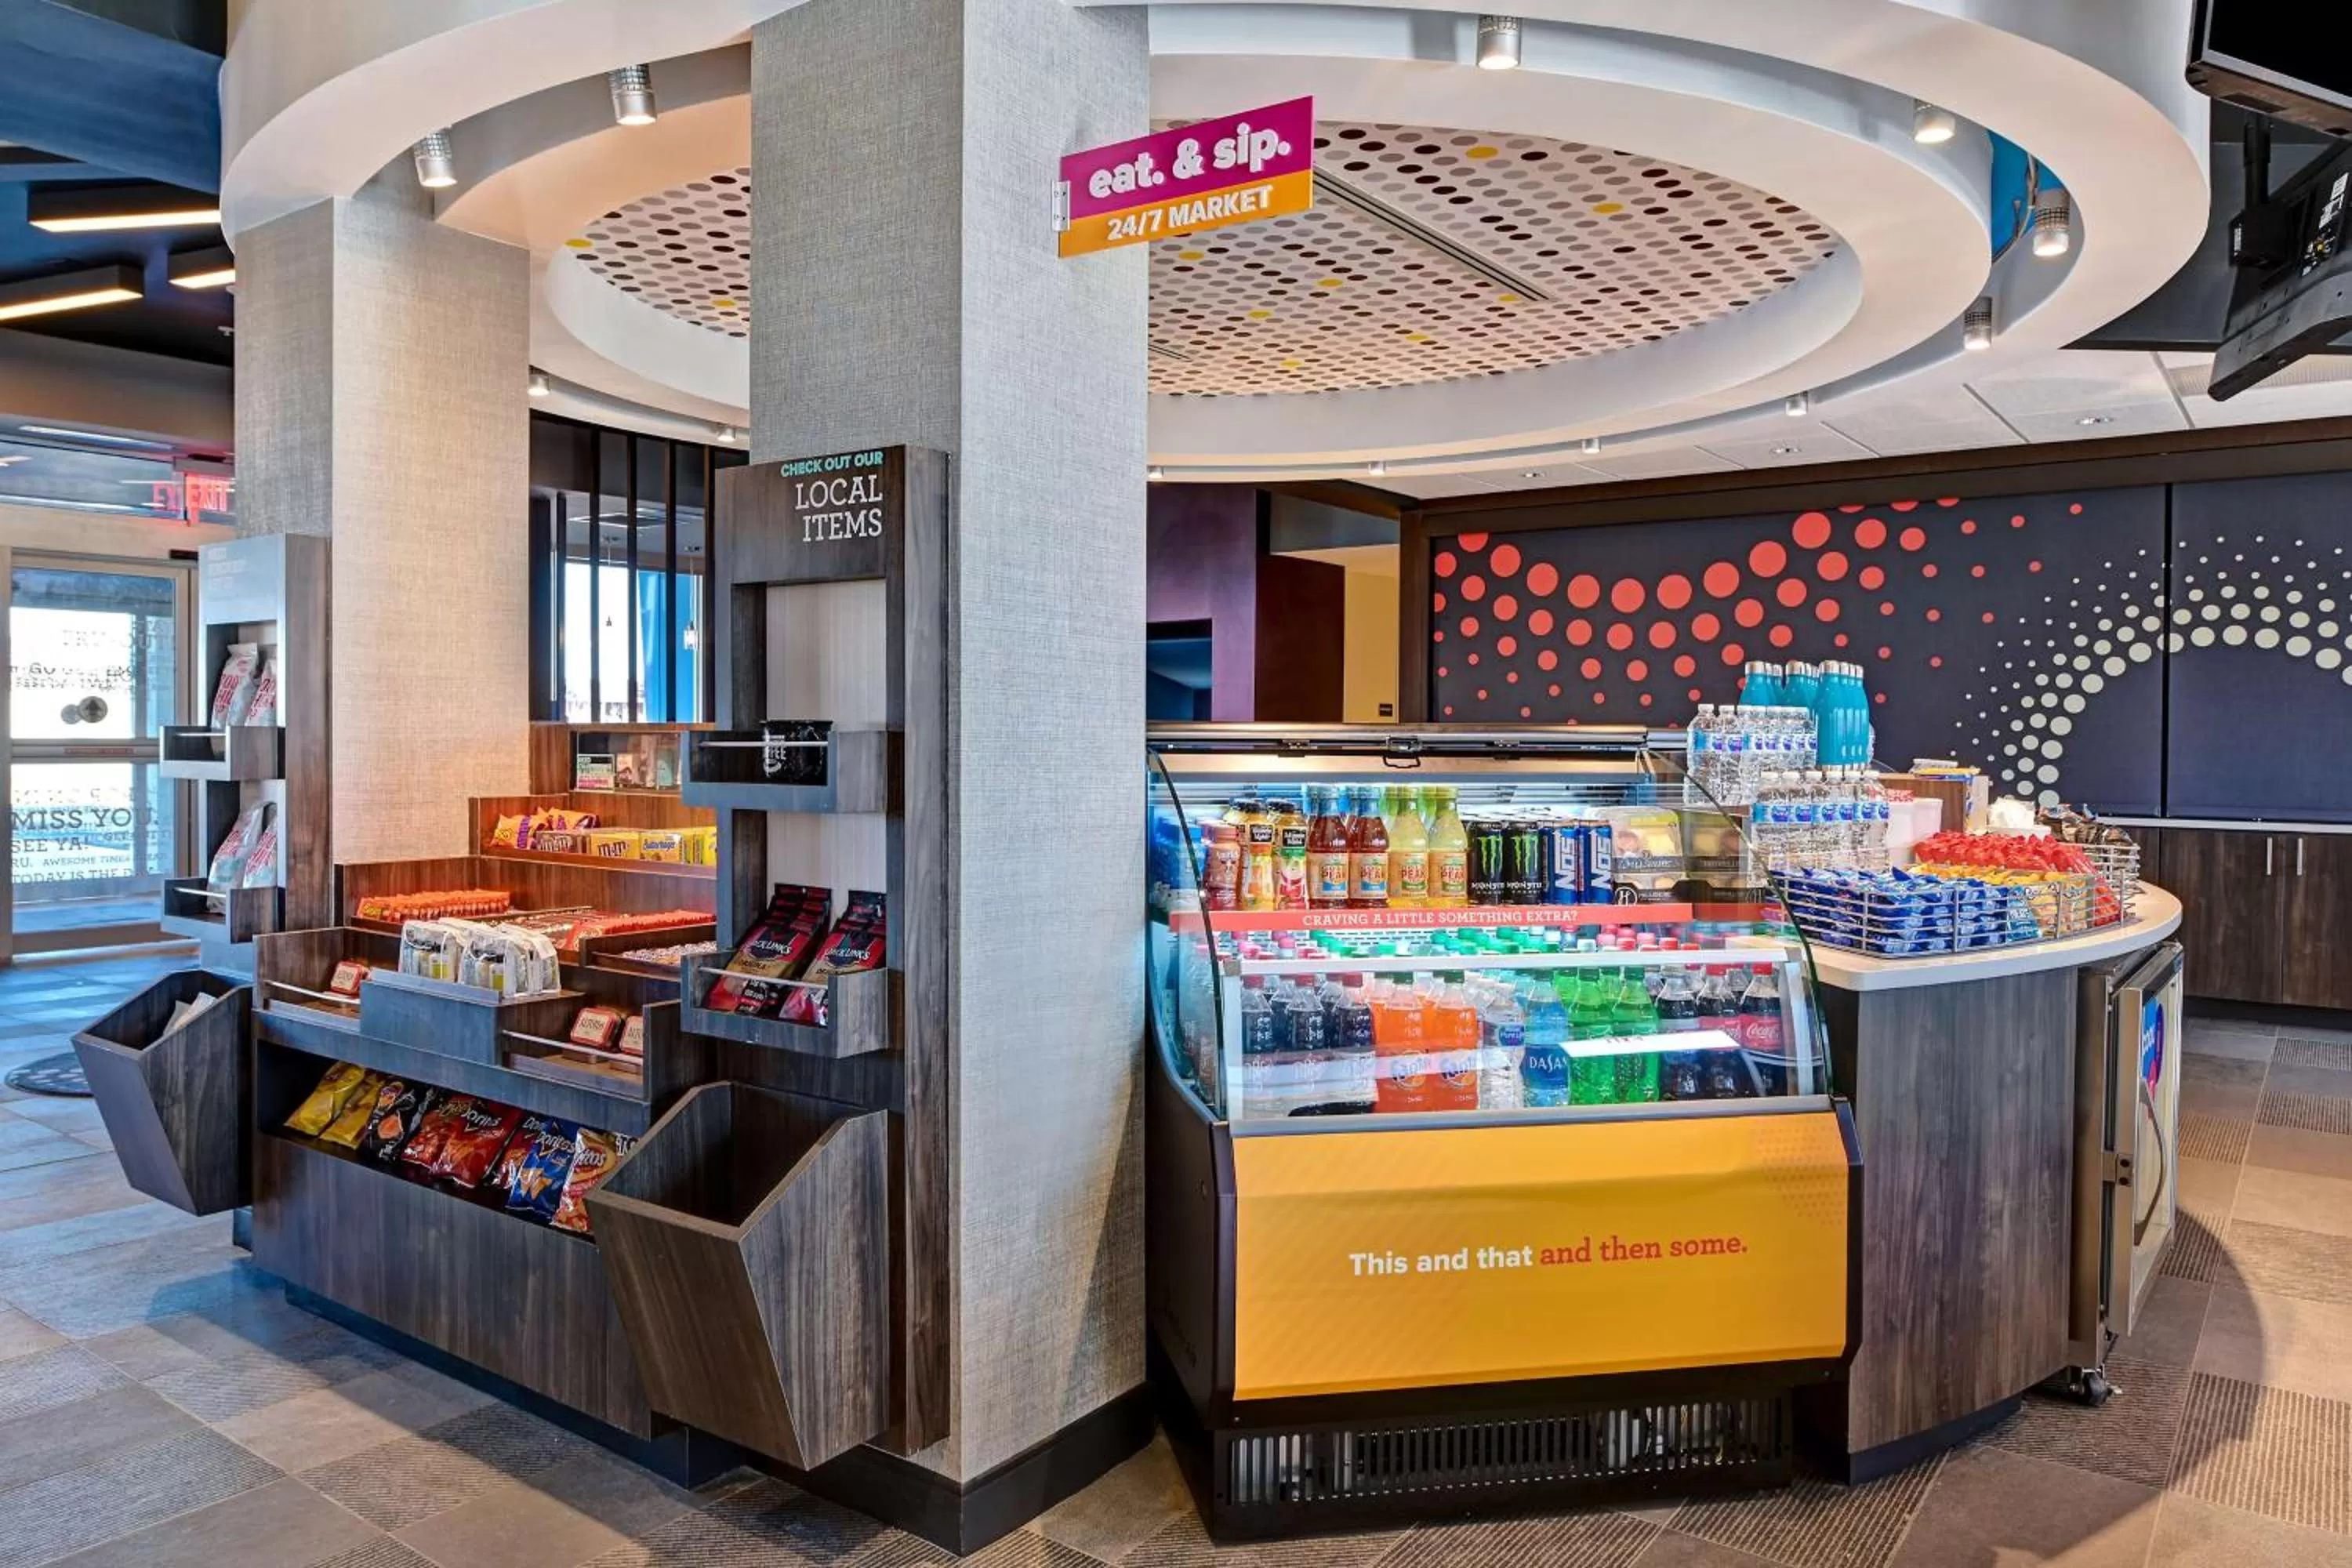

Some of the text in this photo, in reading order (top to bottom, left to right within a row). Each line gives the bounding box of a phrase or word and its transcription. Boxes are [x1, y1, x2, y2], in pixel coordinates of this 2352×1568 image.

[1089, 122, 1291, 198] eat. & sip.
[1107, 184, 1273, 241] 24/7 MARKET
[780, 451, 884, 477] CHECK OUT OUR
[795, 474, 884, 510] LOCAL
[803, 507, 883, 542] ITEMS
[11, 810, 82, 830] MISS
[11, 838, 48, 853] SEE
[13, 871, 66, 884] TODAY
[1303, 909, 1577, 926] CRAVING A LITTLE SOMETHING EXTRA?
[1349, 1235, 1748, 1276] This and that and then some.
